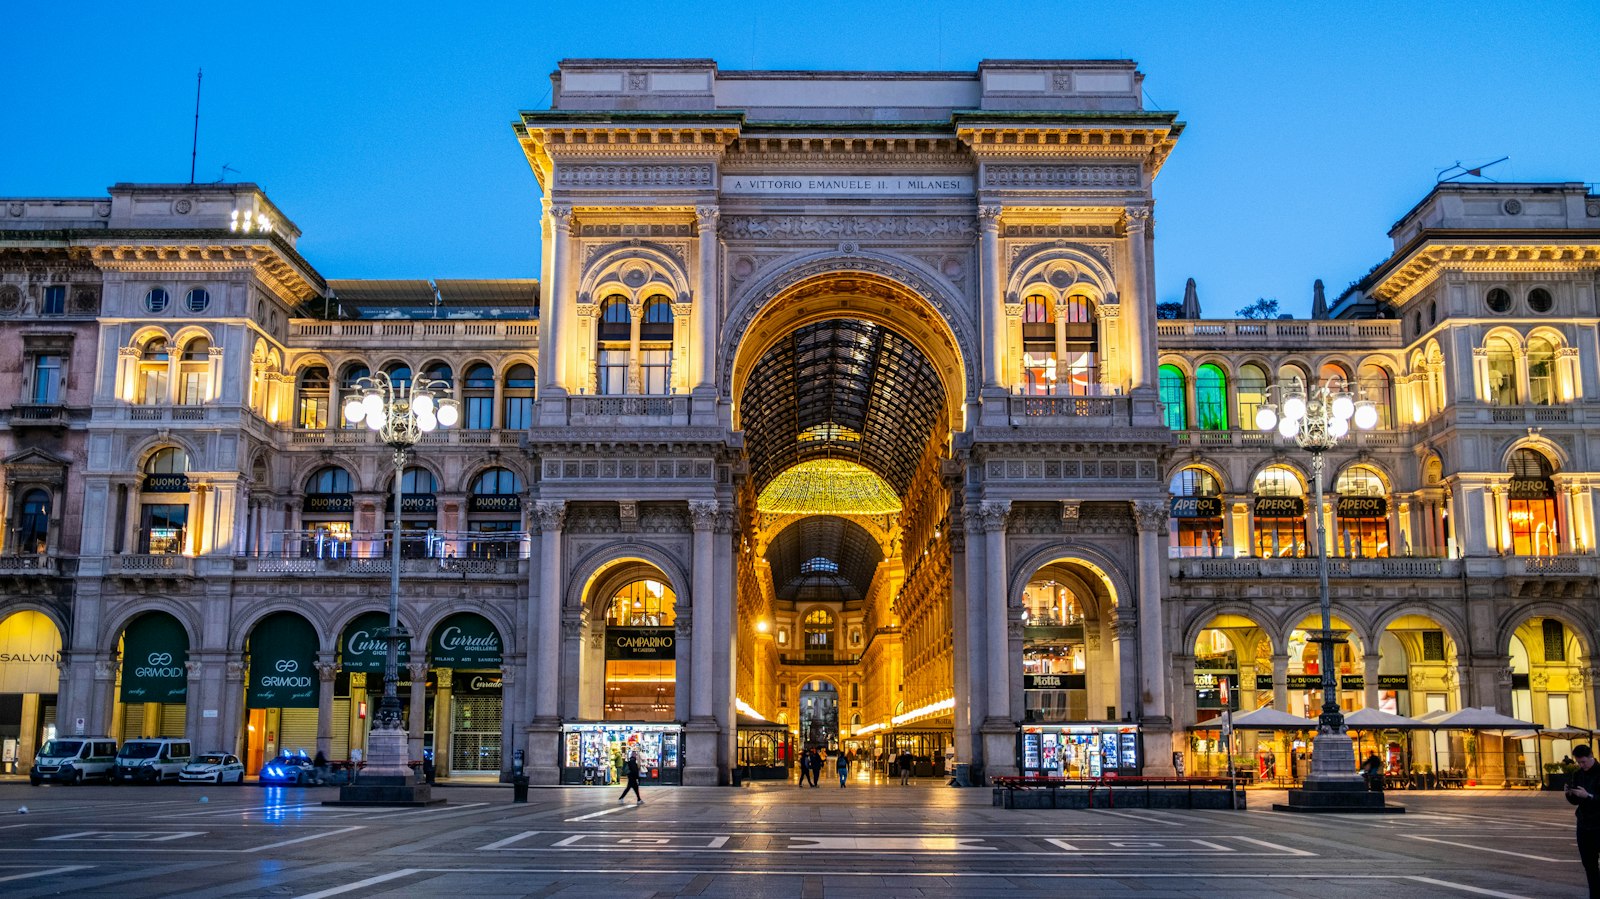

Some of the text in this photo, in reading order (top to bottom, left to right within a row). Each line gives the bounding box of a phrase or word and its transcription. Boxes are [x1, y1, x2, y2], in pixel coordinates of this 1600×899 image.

[734, 181, 742, 189] A
[750, 181, 802, 189] VITTORIO
[809, 181, 871, 189] EMANUELE
[907, 181, 960, 189] MILANESI
[150, 478, 180, 486] DUOMO
[1508, 480, 1549, 491] APEROL
[311, 498, 352, 507] DUOMO 21
[401, 498, 434, 507] UOMO 21
[476, 497, 518, 506] DUOMO 21
[1173, 499, 1214, 510] APEROL
[1256, 499, 1297, 510] APEROL
[1338, 499, 1379, 510] APEROL
[348, 631, 406, 655] Currao
[440, 626, 499, 650] Currado
[616, 636, 673, 648] CAMPARINO
[0, 653, 59, 662] SALVINI
[135, 667, 183, 678] GRIMOLDI
[261, 676, 312, 687] GRIMOLDI
[470, 676, 503, 691] Currado
[1033, 675, 1062, 686] Motta
